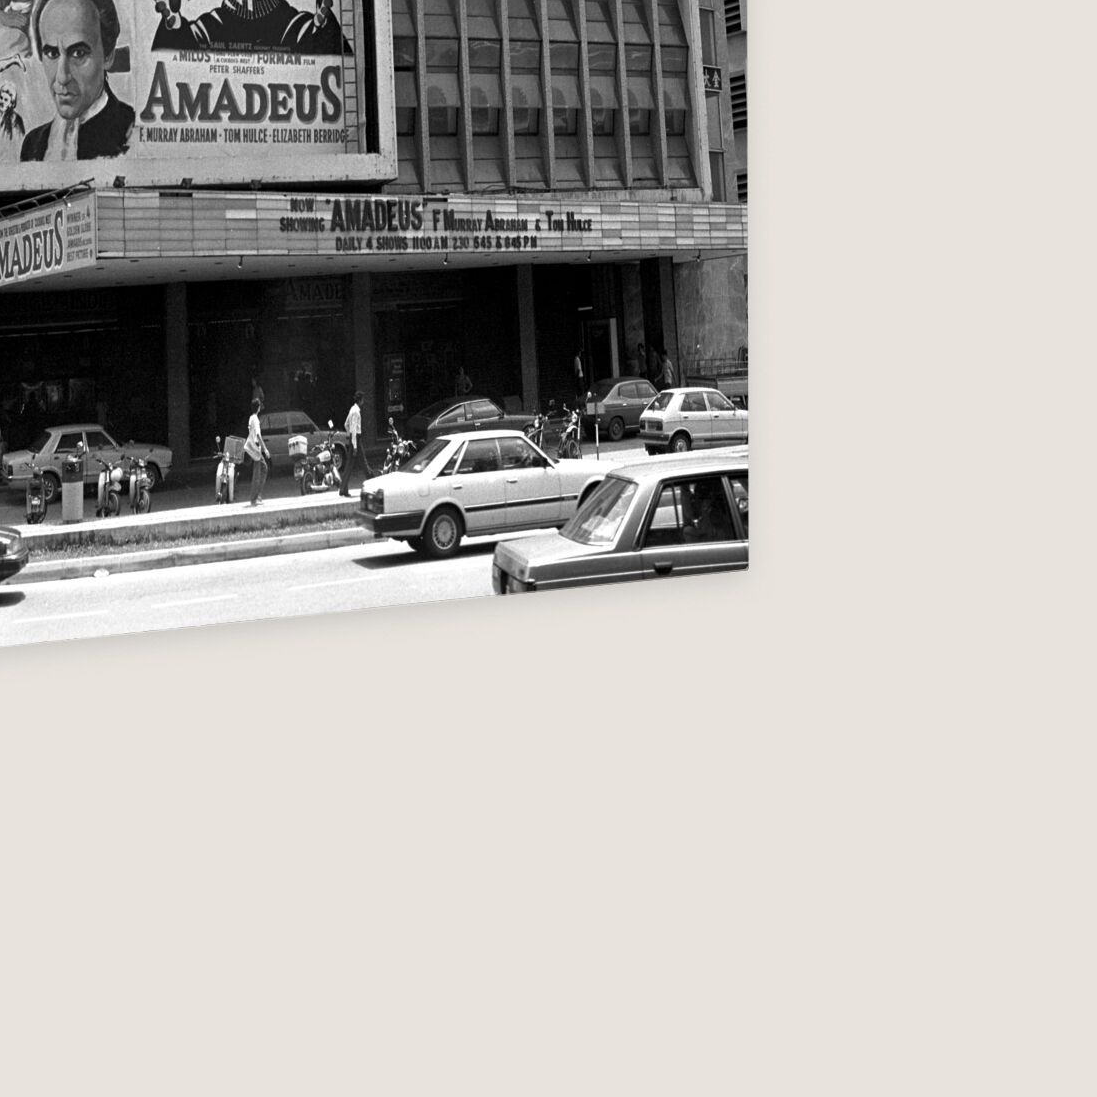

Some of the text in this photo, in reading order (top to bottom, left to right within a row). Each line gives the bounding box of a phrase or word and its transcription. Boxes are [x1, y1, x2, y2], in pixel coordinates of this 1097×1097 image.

[173, 54, 178, 62] A
[179, 52, 211, 63] MILOS
[257, 53, 301, 65] FORMAN
[209, 64, 230, 74] PETER
[139, 60, 343, 125] AMADEUS
[139, 128, 146, 144] F.
[146, 128, 178, 144] MURRAY
[179, 128, 218, 144] ABRAHAM
[223, 128, 242, 144] TOM
[242, 128, 268, 144] HULCE
[272, 128, 312, 144] ELIZABETH
[290, 198, 315, 212] NOW
[279, 217, 325, 232] SHOWING
[433, 209, 440, 231] F
[535, 219, 541, 231] &
[335, 236, 362, 251] DAILY
[366, 236, 373, 250] 4
[376, 235, 408, 251] SHOWS
